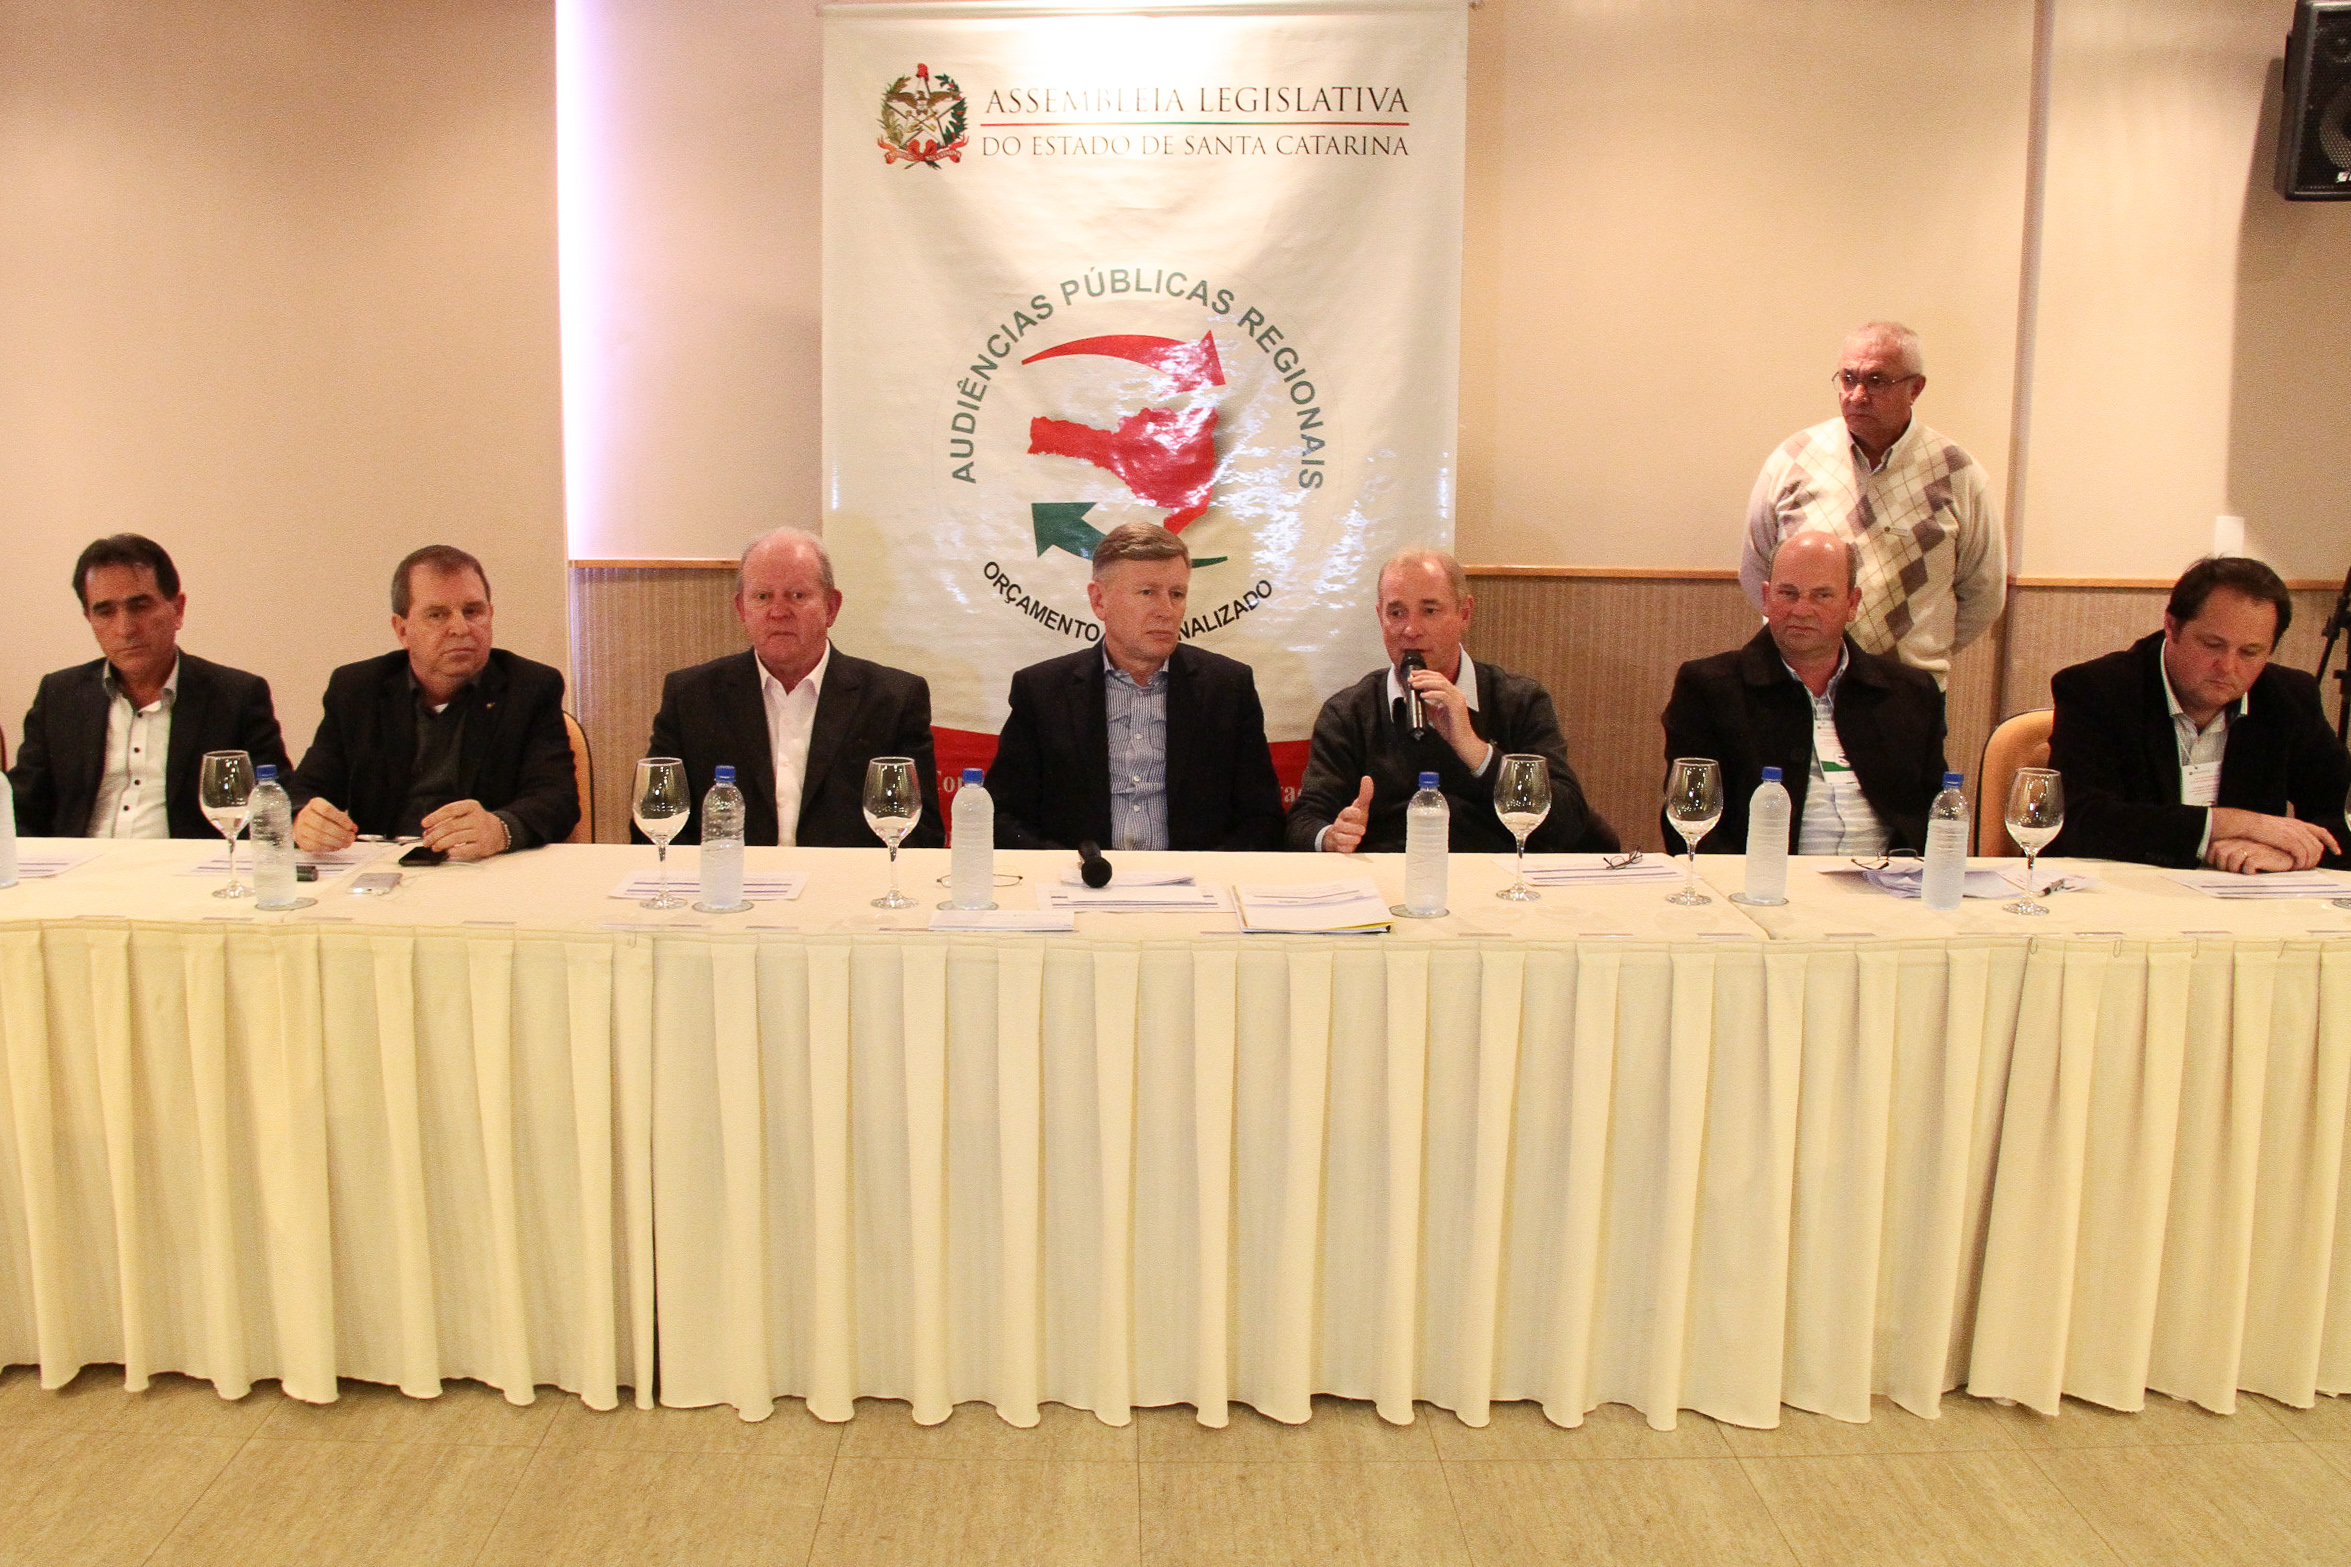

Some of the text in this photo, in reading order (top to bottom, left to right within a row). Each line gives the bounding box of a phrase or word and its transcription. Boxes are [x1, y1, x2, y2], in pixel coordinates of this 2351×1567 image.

[986, 86, 1410, 113] ASSEMBLEIA LEGISLATIVA
[983, 136, 1021, 156] DO
[1033, 136, 1130, 156] ESTADO
[1142, 135, 1174, 155] DE
[1185, 135, 1266, 155] SANTA
[1276, 135, 1409, 156] CATARINA
[950, 266, 1325, 489] AUDIÊNCIAS PÚBLICAS REGIONAIS
[983, 561, 1272, 642] ORÇAMENTO NALIZADO
